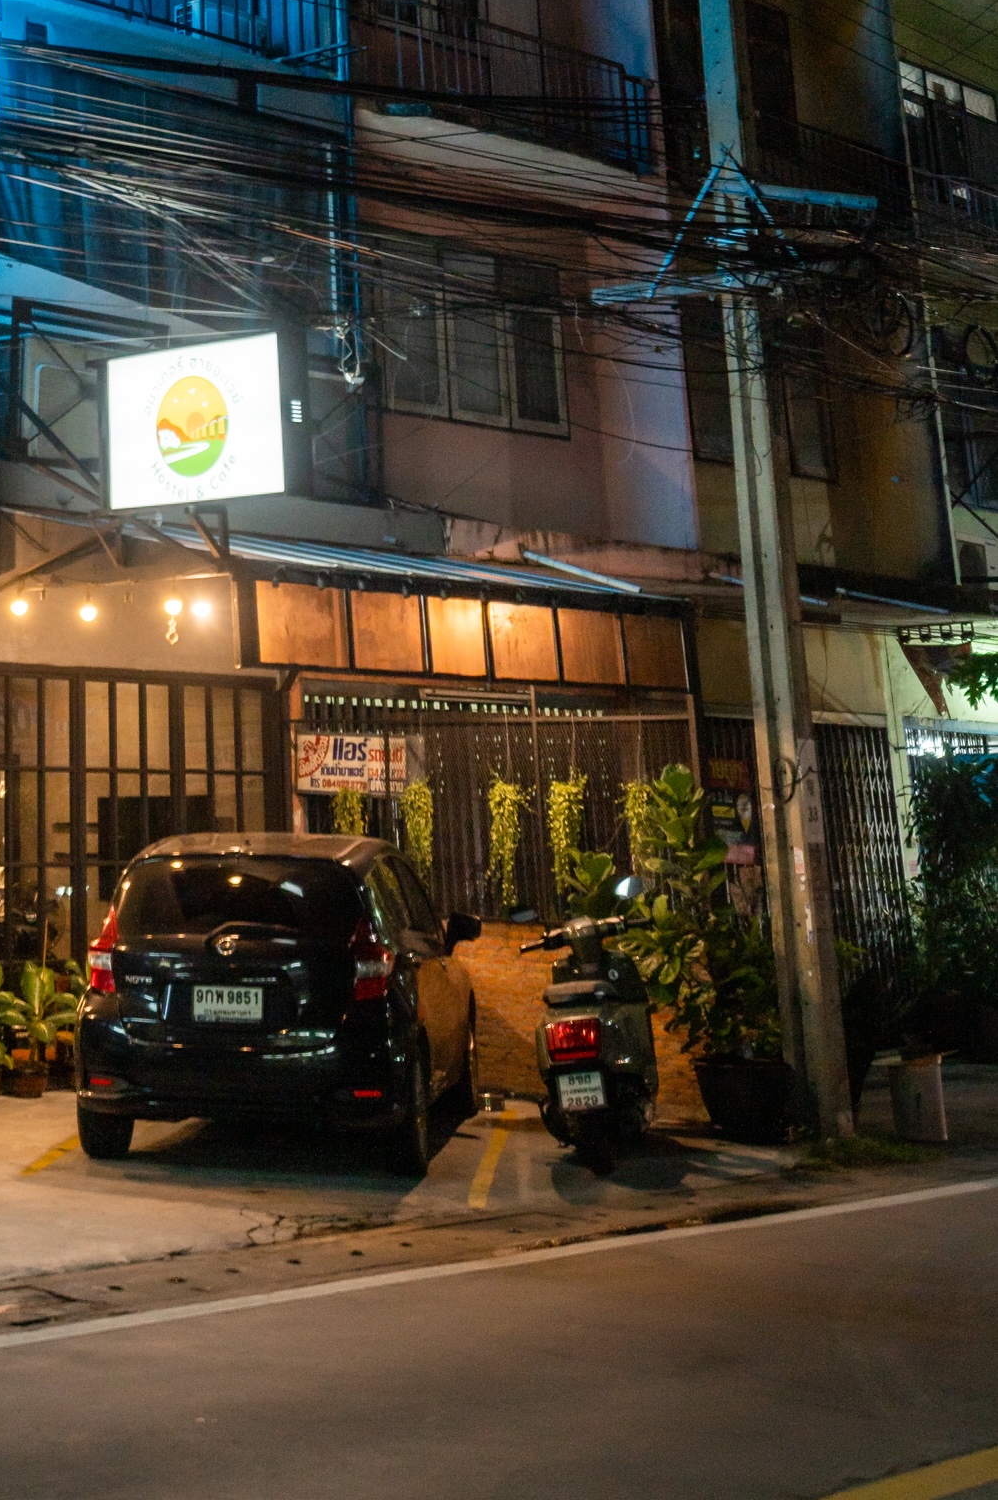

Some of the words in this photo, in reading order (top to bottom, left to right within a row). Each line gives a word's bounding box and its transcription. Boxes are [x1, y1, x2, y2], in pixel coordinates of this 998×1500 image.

[151, 461, 190, 499] Hostel
[196, 484, 205, 499] &
[210, 455, 237, 490] Cafe
[332, 738, 371, 762] แอร์
[227, 990, 259, 1005] 9851
